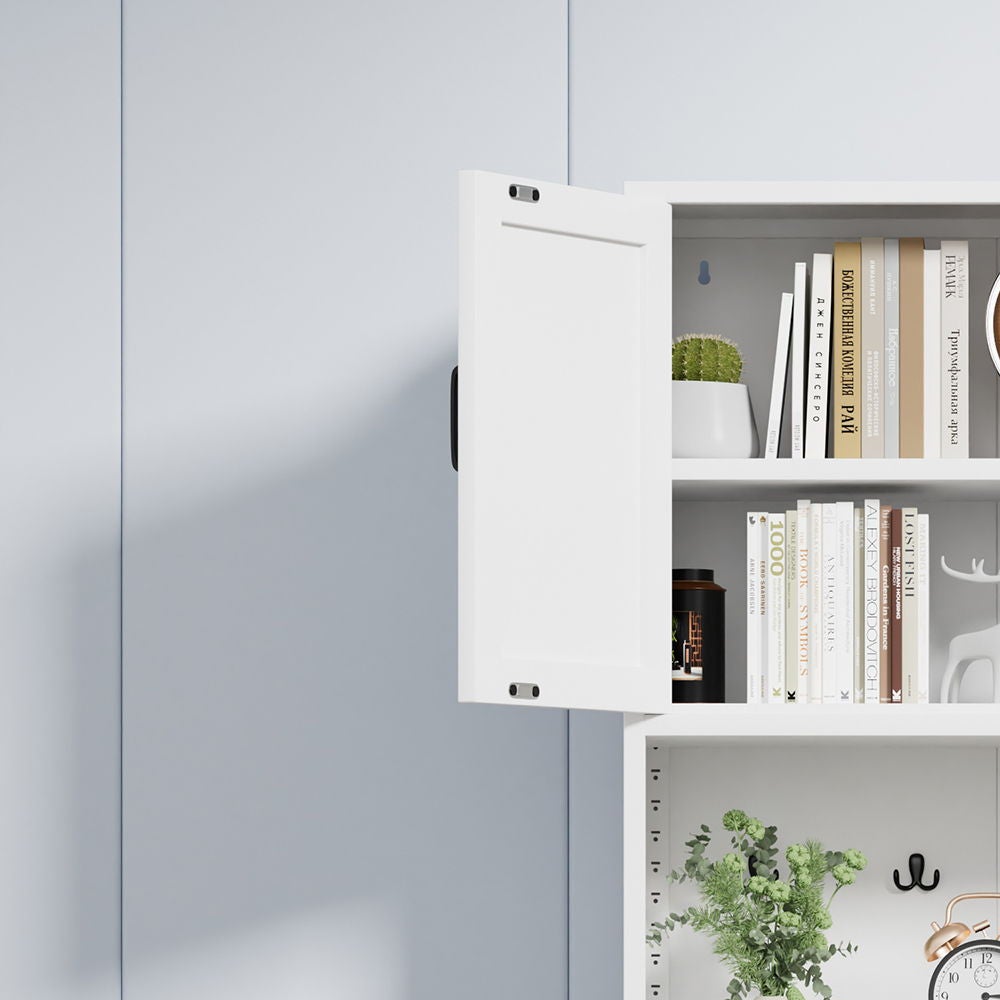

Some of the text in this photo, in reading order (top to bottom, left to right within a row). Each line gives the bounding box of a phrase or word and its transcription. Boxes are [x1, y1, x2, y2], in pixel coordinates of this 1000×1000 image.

[812, 298, 825, 423] ДЖЕН СИНСЕРО
[840, 269, 858, 433] БОЖЕСТВЕННАЯ КОМЕДИЯ РАЙ
[948, 328, 961, 446] Триумфальная арка
[770, 521, 784, 577] 1000
[905, 514, 914, 597] LOST FISH
[800, 549, 809, 676] BOOK SYMBOLS
[866, 505, 878, 690] ALEXEY BRODOVITCH
[882, 606, 889, 615] in
[949, 972, 959, 983] 10
[964, 958, 972, 968] 11
[981, 953, 993, 963] 12
